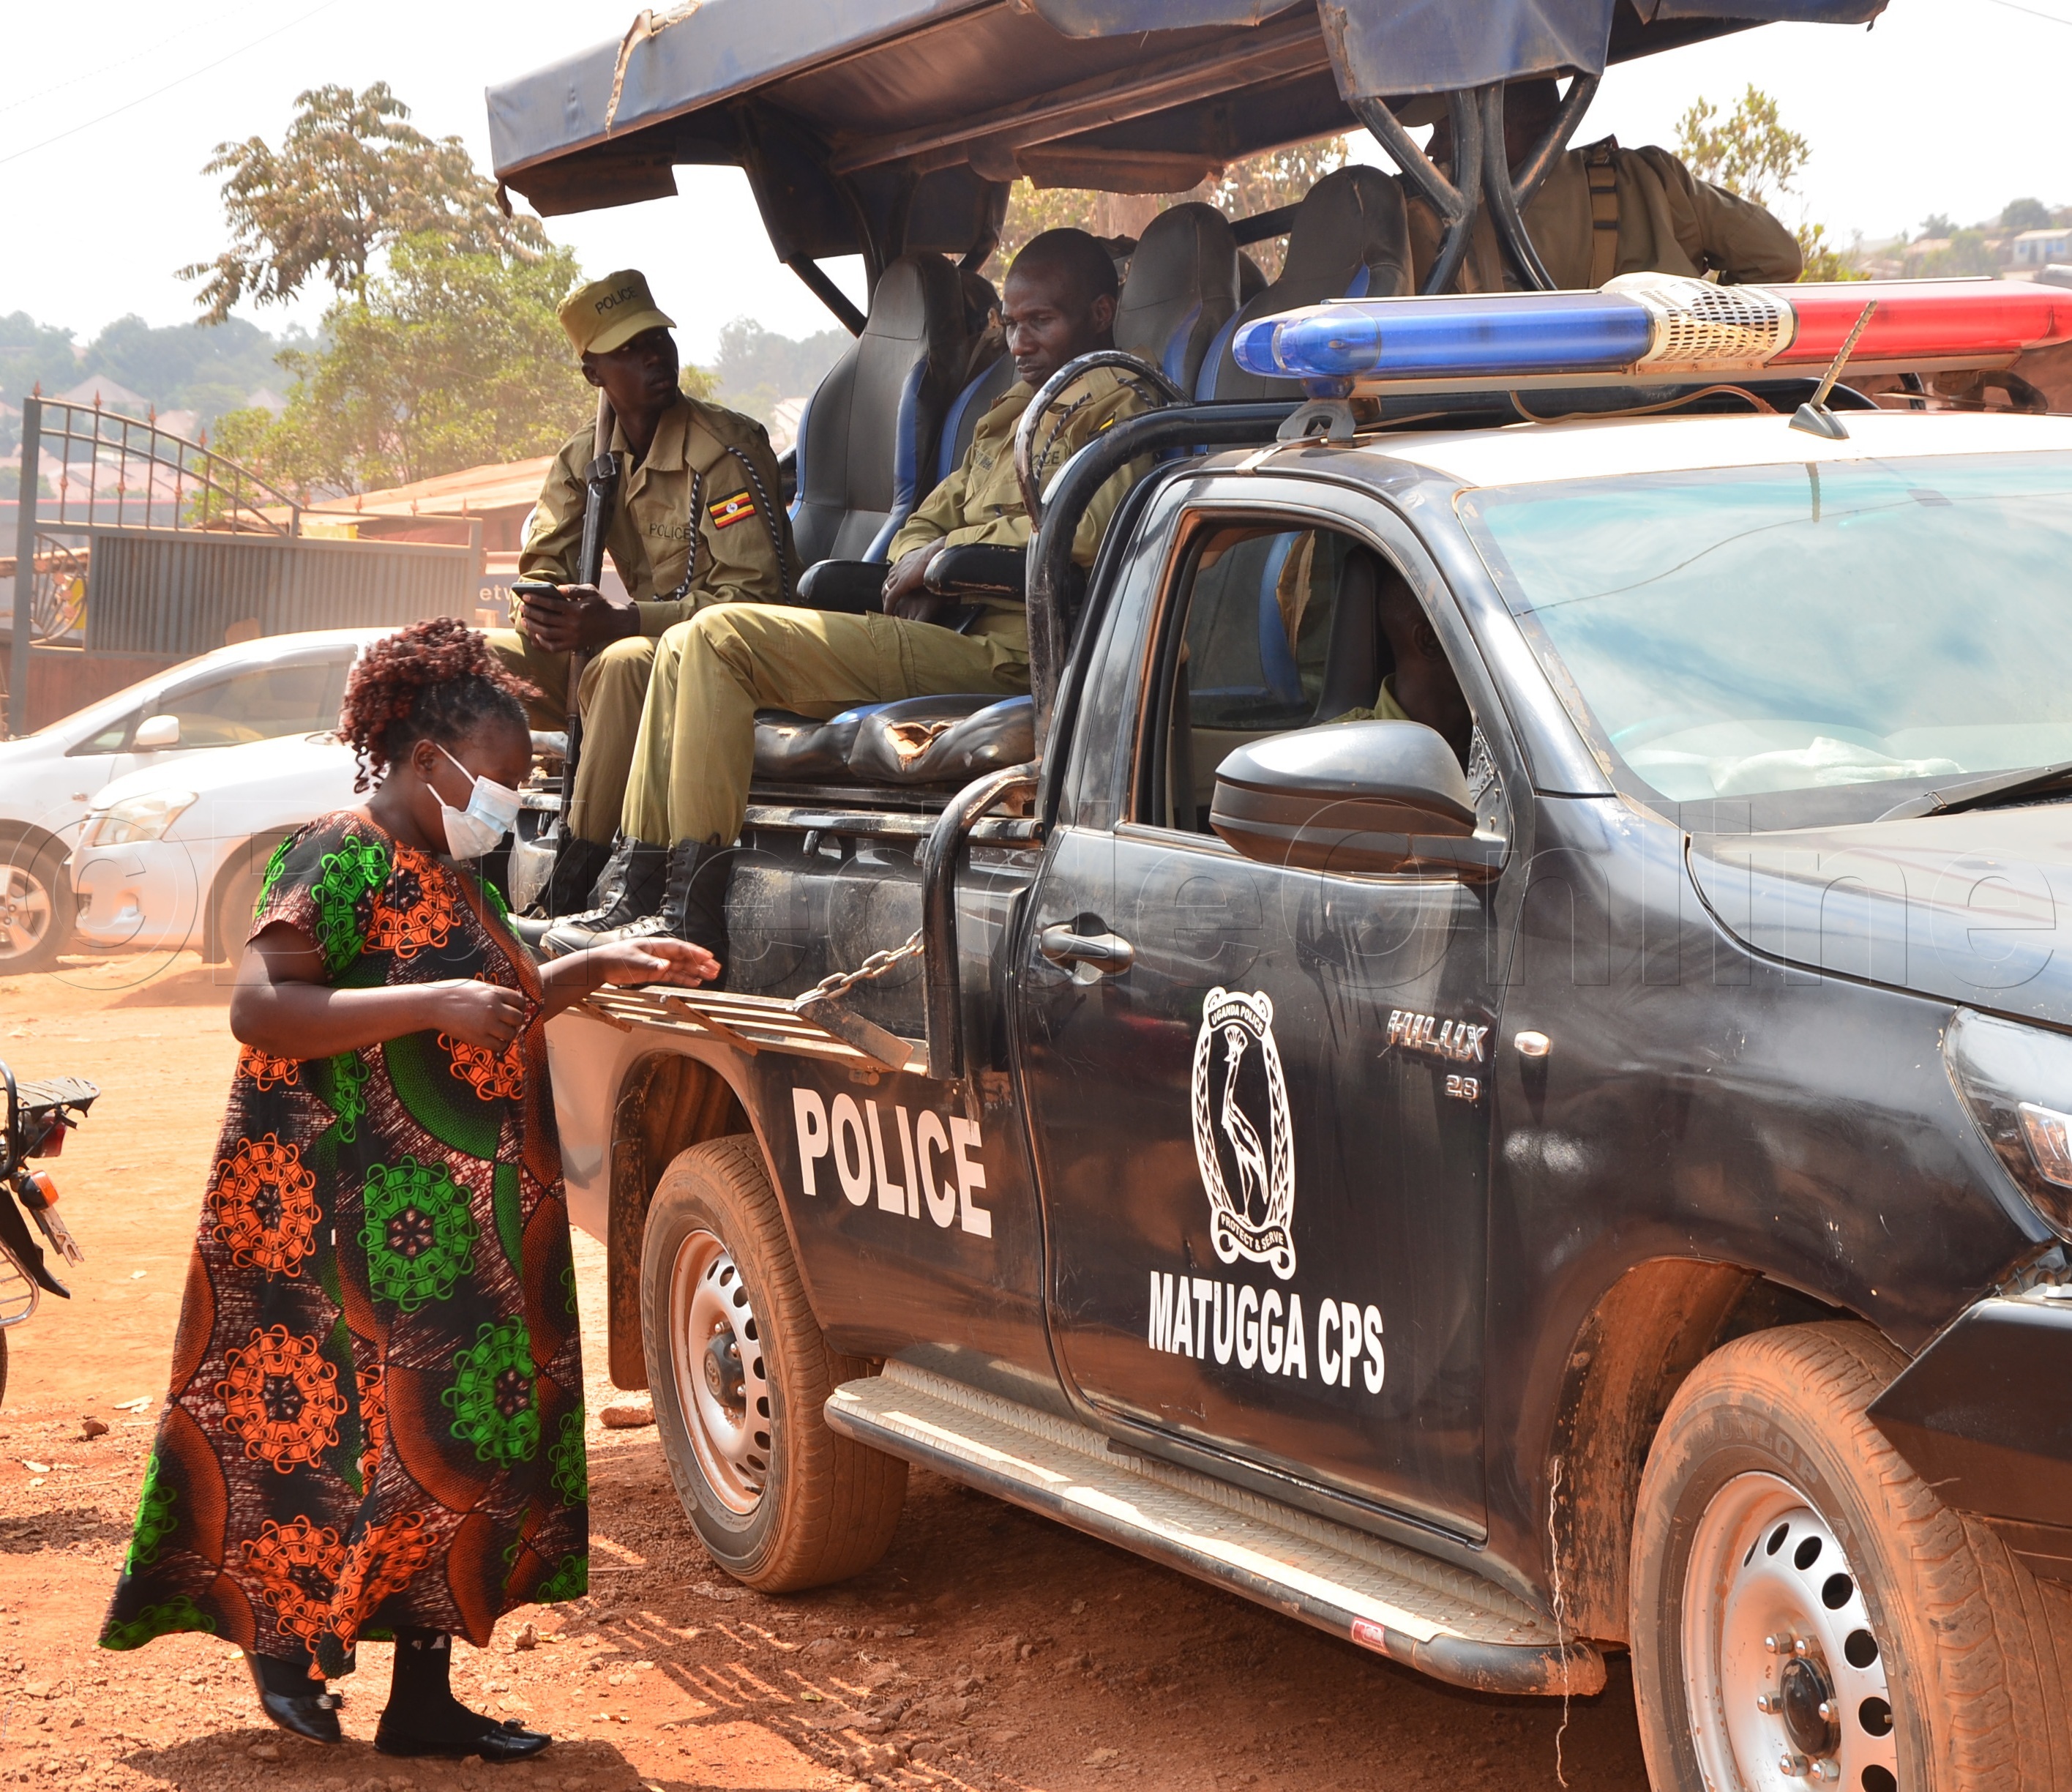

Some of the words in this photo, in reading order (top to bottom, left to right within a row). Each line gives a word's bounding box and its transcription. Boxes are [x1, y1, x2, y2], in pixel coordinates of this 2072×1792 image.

[595, 286, 637, 315] POLICE
[649, 523, 691, 540] POLICE
[1211, 1004, 1240, 1026] UGANDA
[1240, 1006, 1264, 1035] POLICE
[793, 1088, 992, 1239] POLICE
[1221, 1214, 1253, 1248] PROTECT
[1261, 1231, 1284, 1250] SERVE
[1148, 1270, 1307, 1379] MATUGGA
[1318, 1298, 1385, 1395] CPS
[1698, 1410, 1819, 1485] DUNLOP
